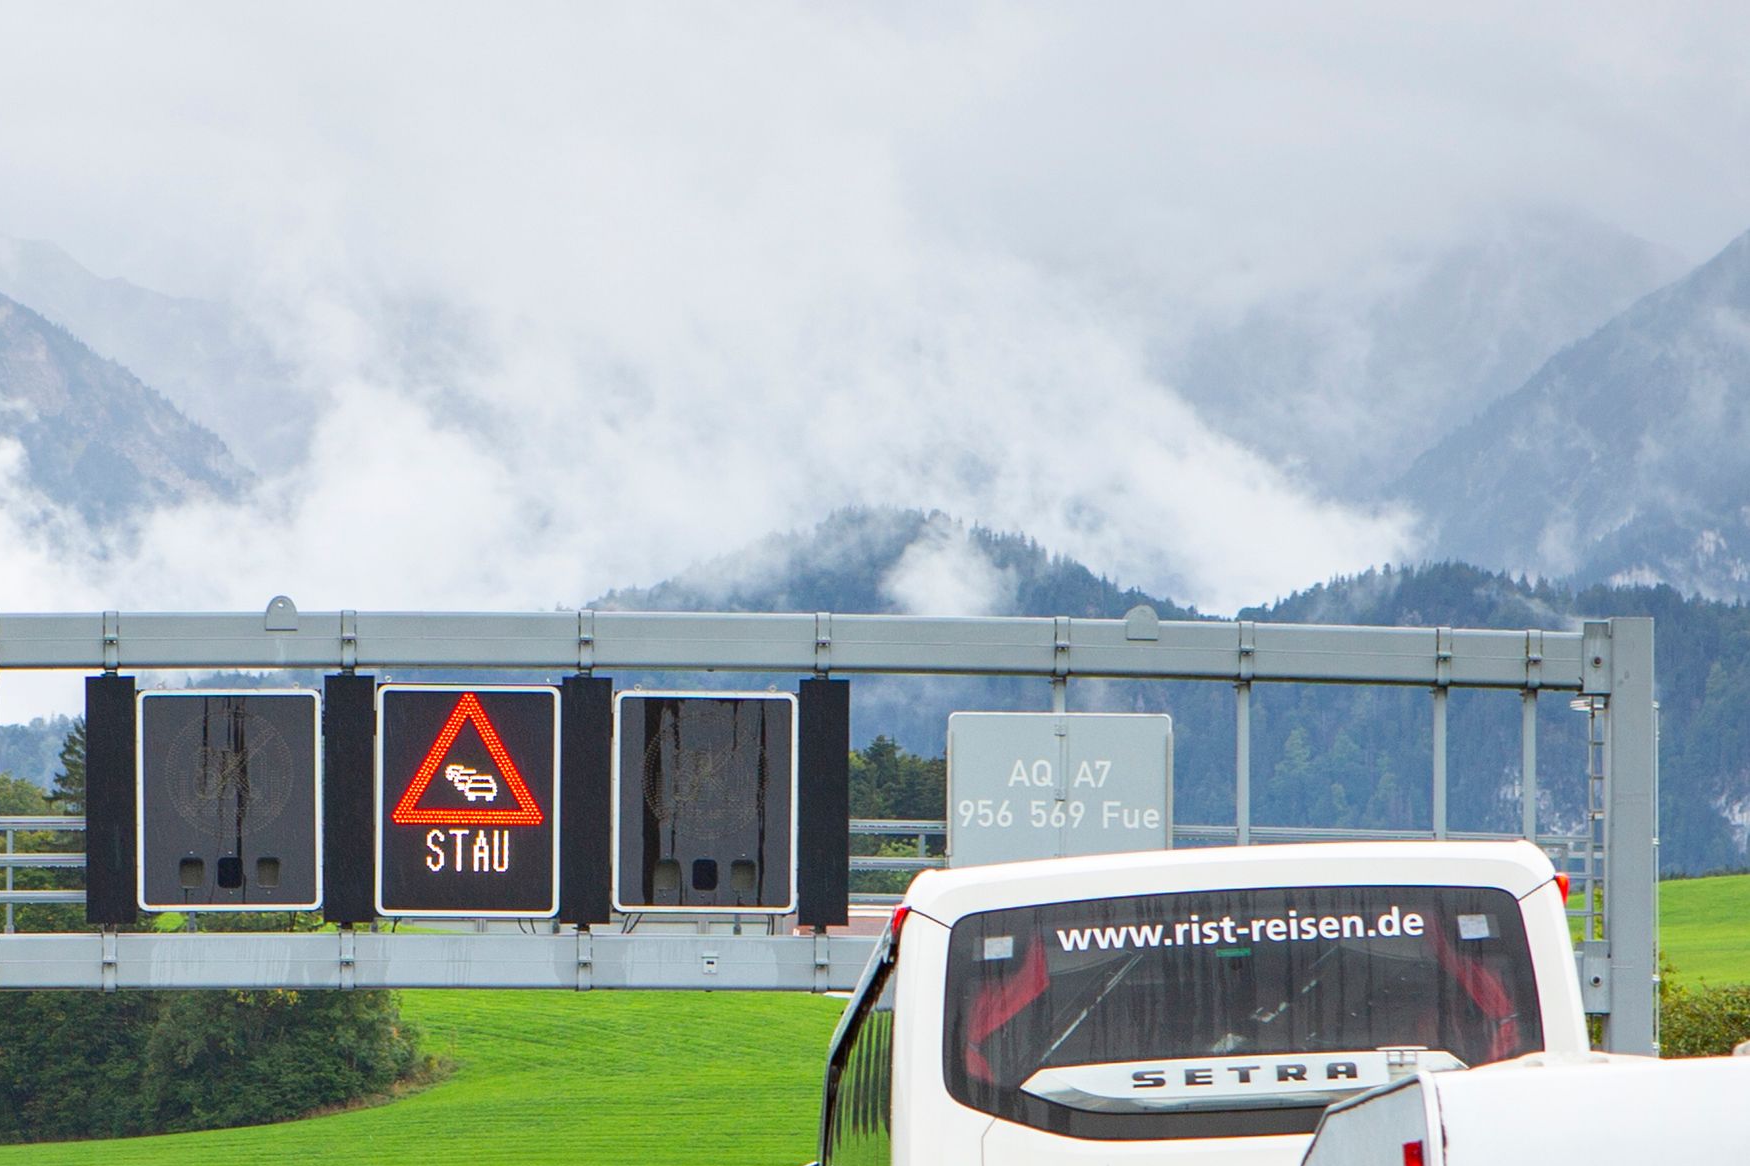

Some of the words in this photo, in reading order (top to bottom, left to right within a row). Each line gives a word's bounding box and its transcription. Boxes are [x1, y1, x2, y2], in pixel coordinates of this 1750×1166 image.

[1008, 759, 1054, 787] AQ
[1073, 760, 1112, 788] A7
[957, 800, 1013, 828] 956
[1030, 801, 1085, 828] 569
[1102, 801, 1160, 829] Fue
[426, 829, 509, 872] STAU
[1056, 906, 1424, 951] www.rist-reisen.de
[1133, 1062, 1358, 1088] SETRA
